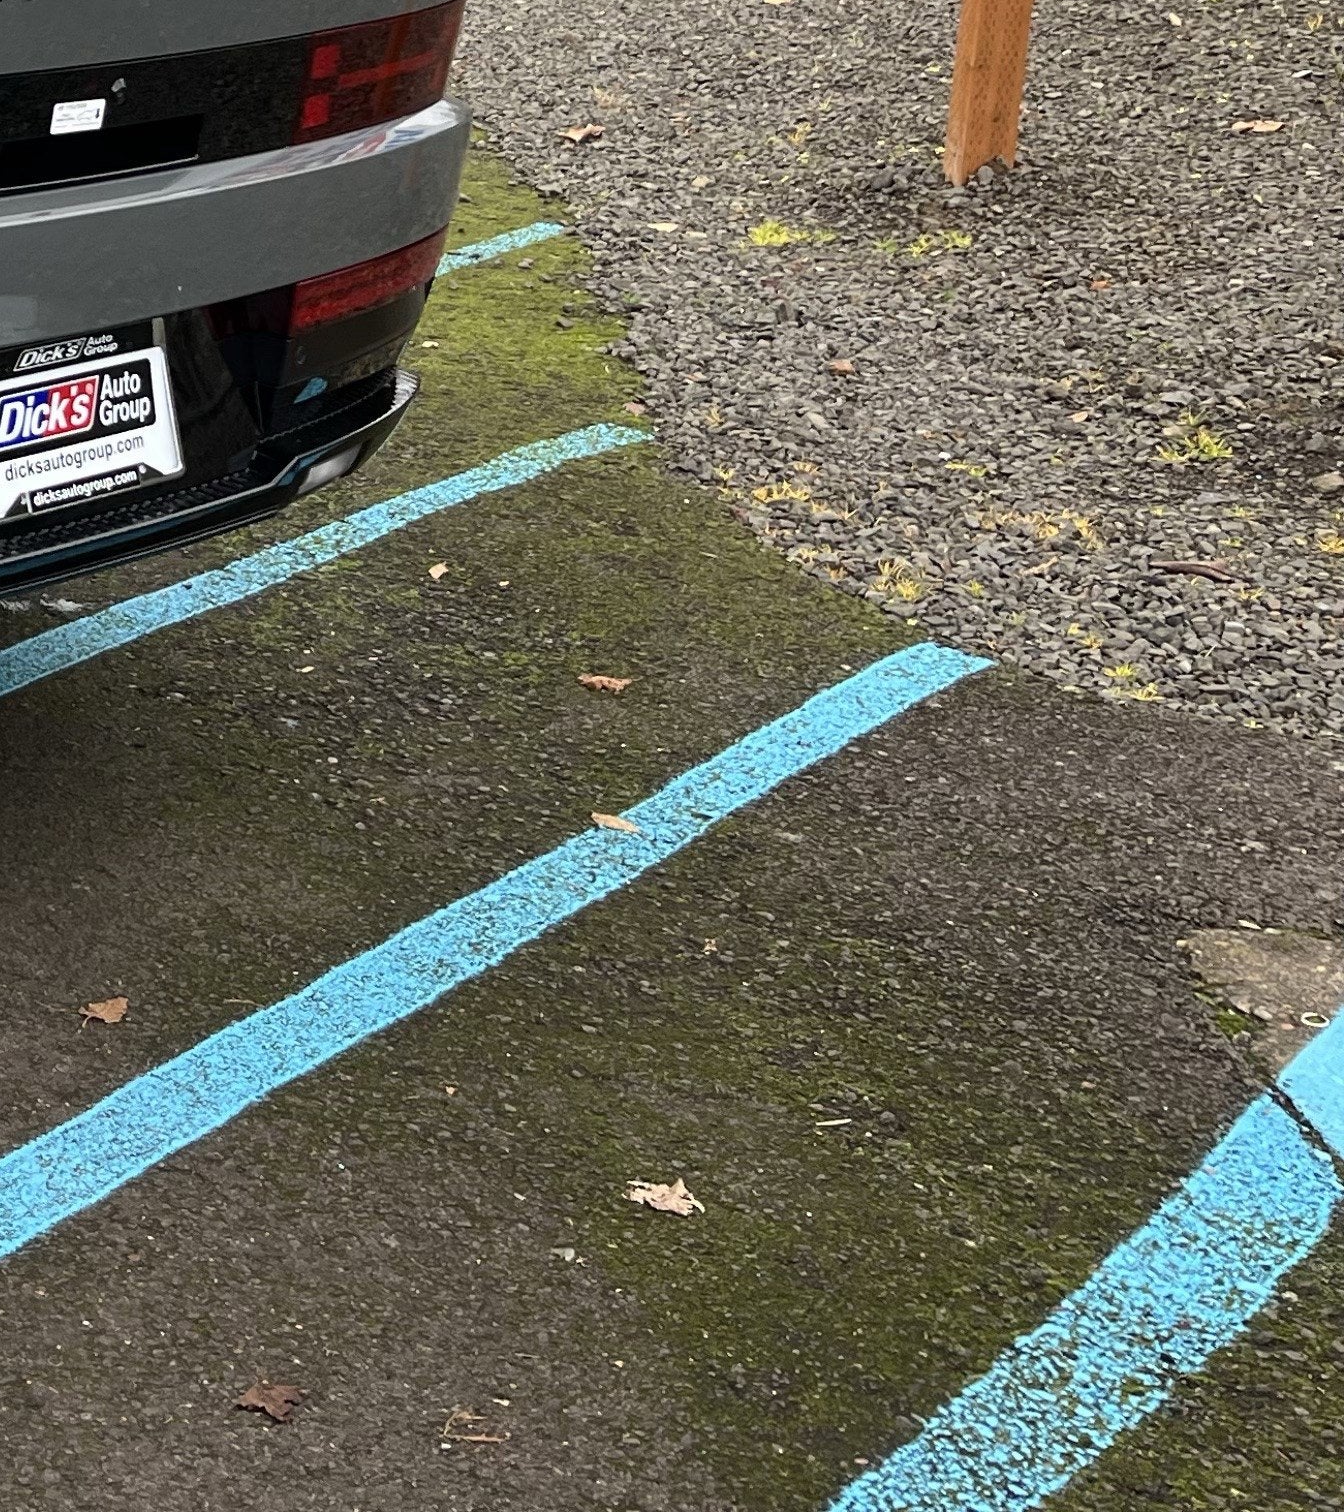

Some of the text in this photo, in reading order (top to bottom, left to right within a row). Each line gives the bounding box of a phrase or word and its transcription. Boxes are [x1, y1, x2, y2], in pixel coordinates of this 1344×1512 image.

[19, 343, 79, 367] Dick's
[84, 342, 118, 356] Group
[86, 335, 113, 346] Auto
[100, 371, 141, 400] Auto
[99, 395, 151, 426] Group
[5, 435, 144, 481] dicksautogroup.com
[34, 470, 137, 506] dicksautogroup.com
